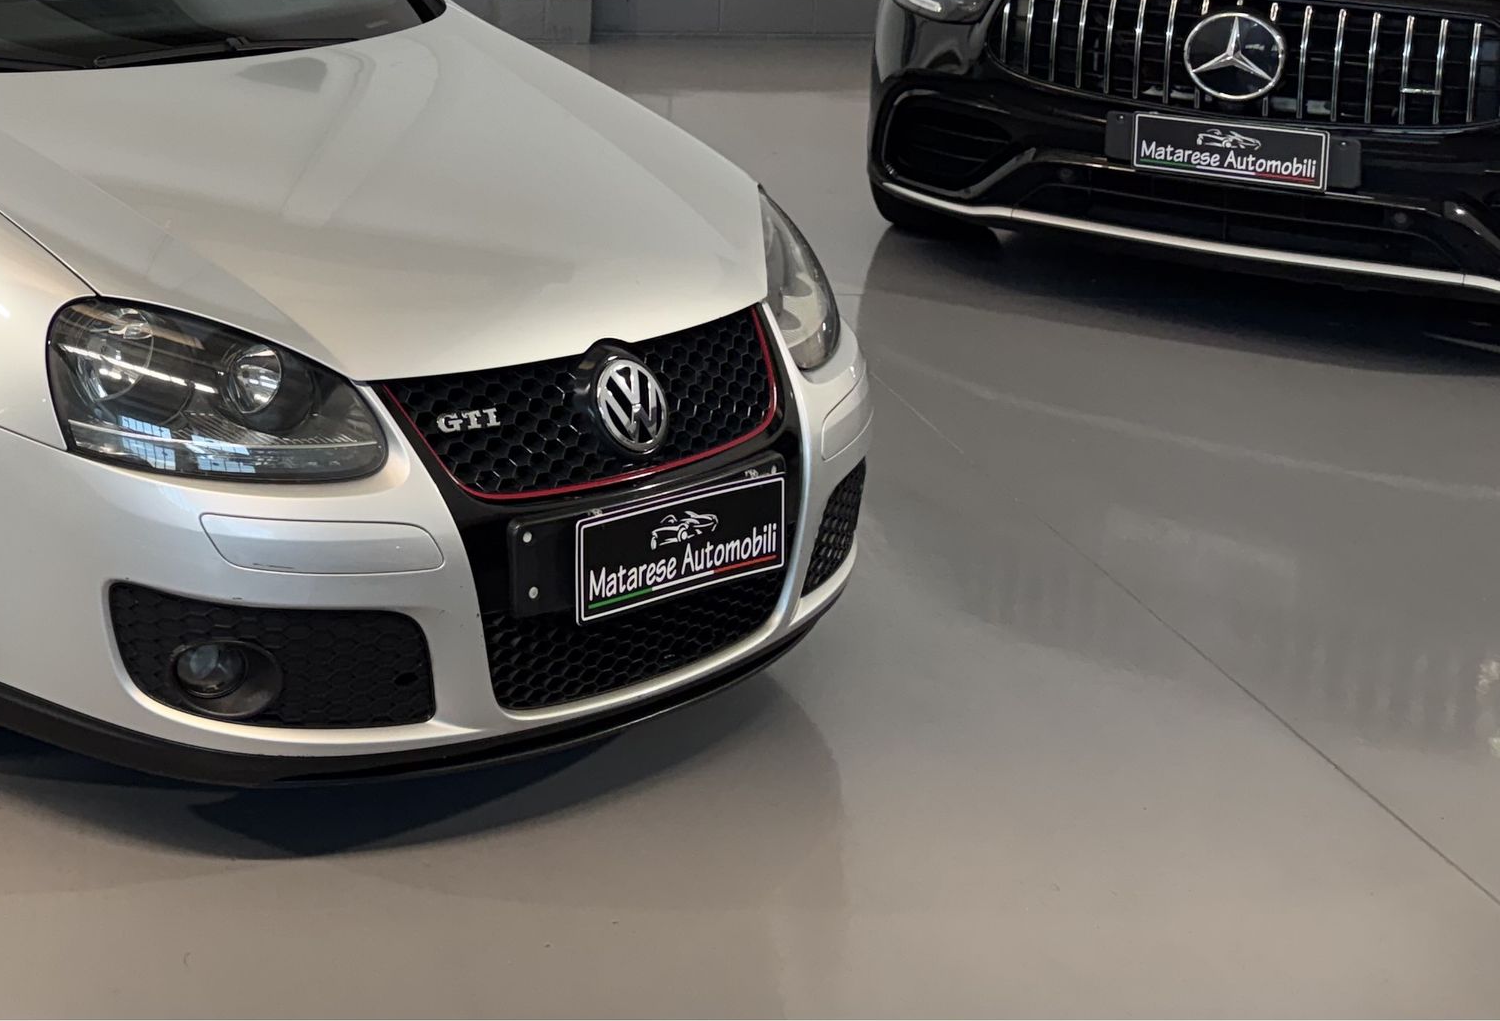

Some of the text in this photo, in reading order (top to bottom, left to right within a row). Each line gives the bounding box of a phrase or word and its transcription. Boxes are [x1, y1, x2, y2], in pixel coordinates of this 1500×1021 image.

[1140, 139, 1317, 178] Matarese Automobili
[436, 407, 501, 434] GTI
[588, 522, 778, 602] Matarese Automobili
